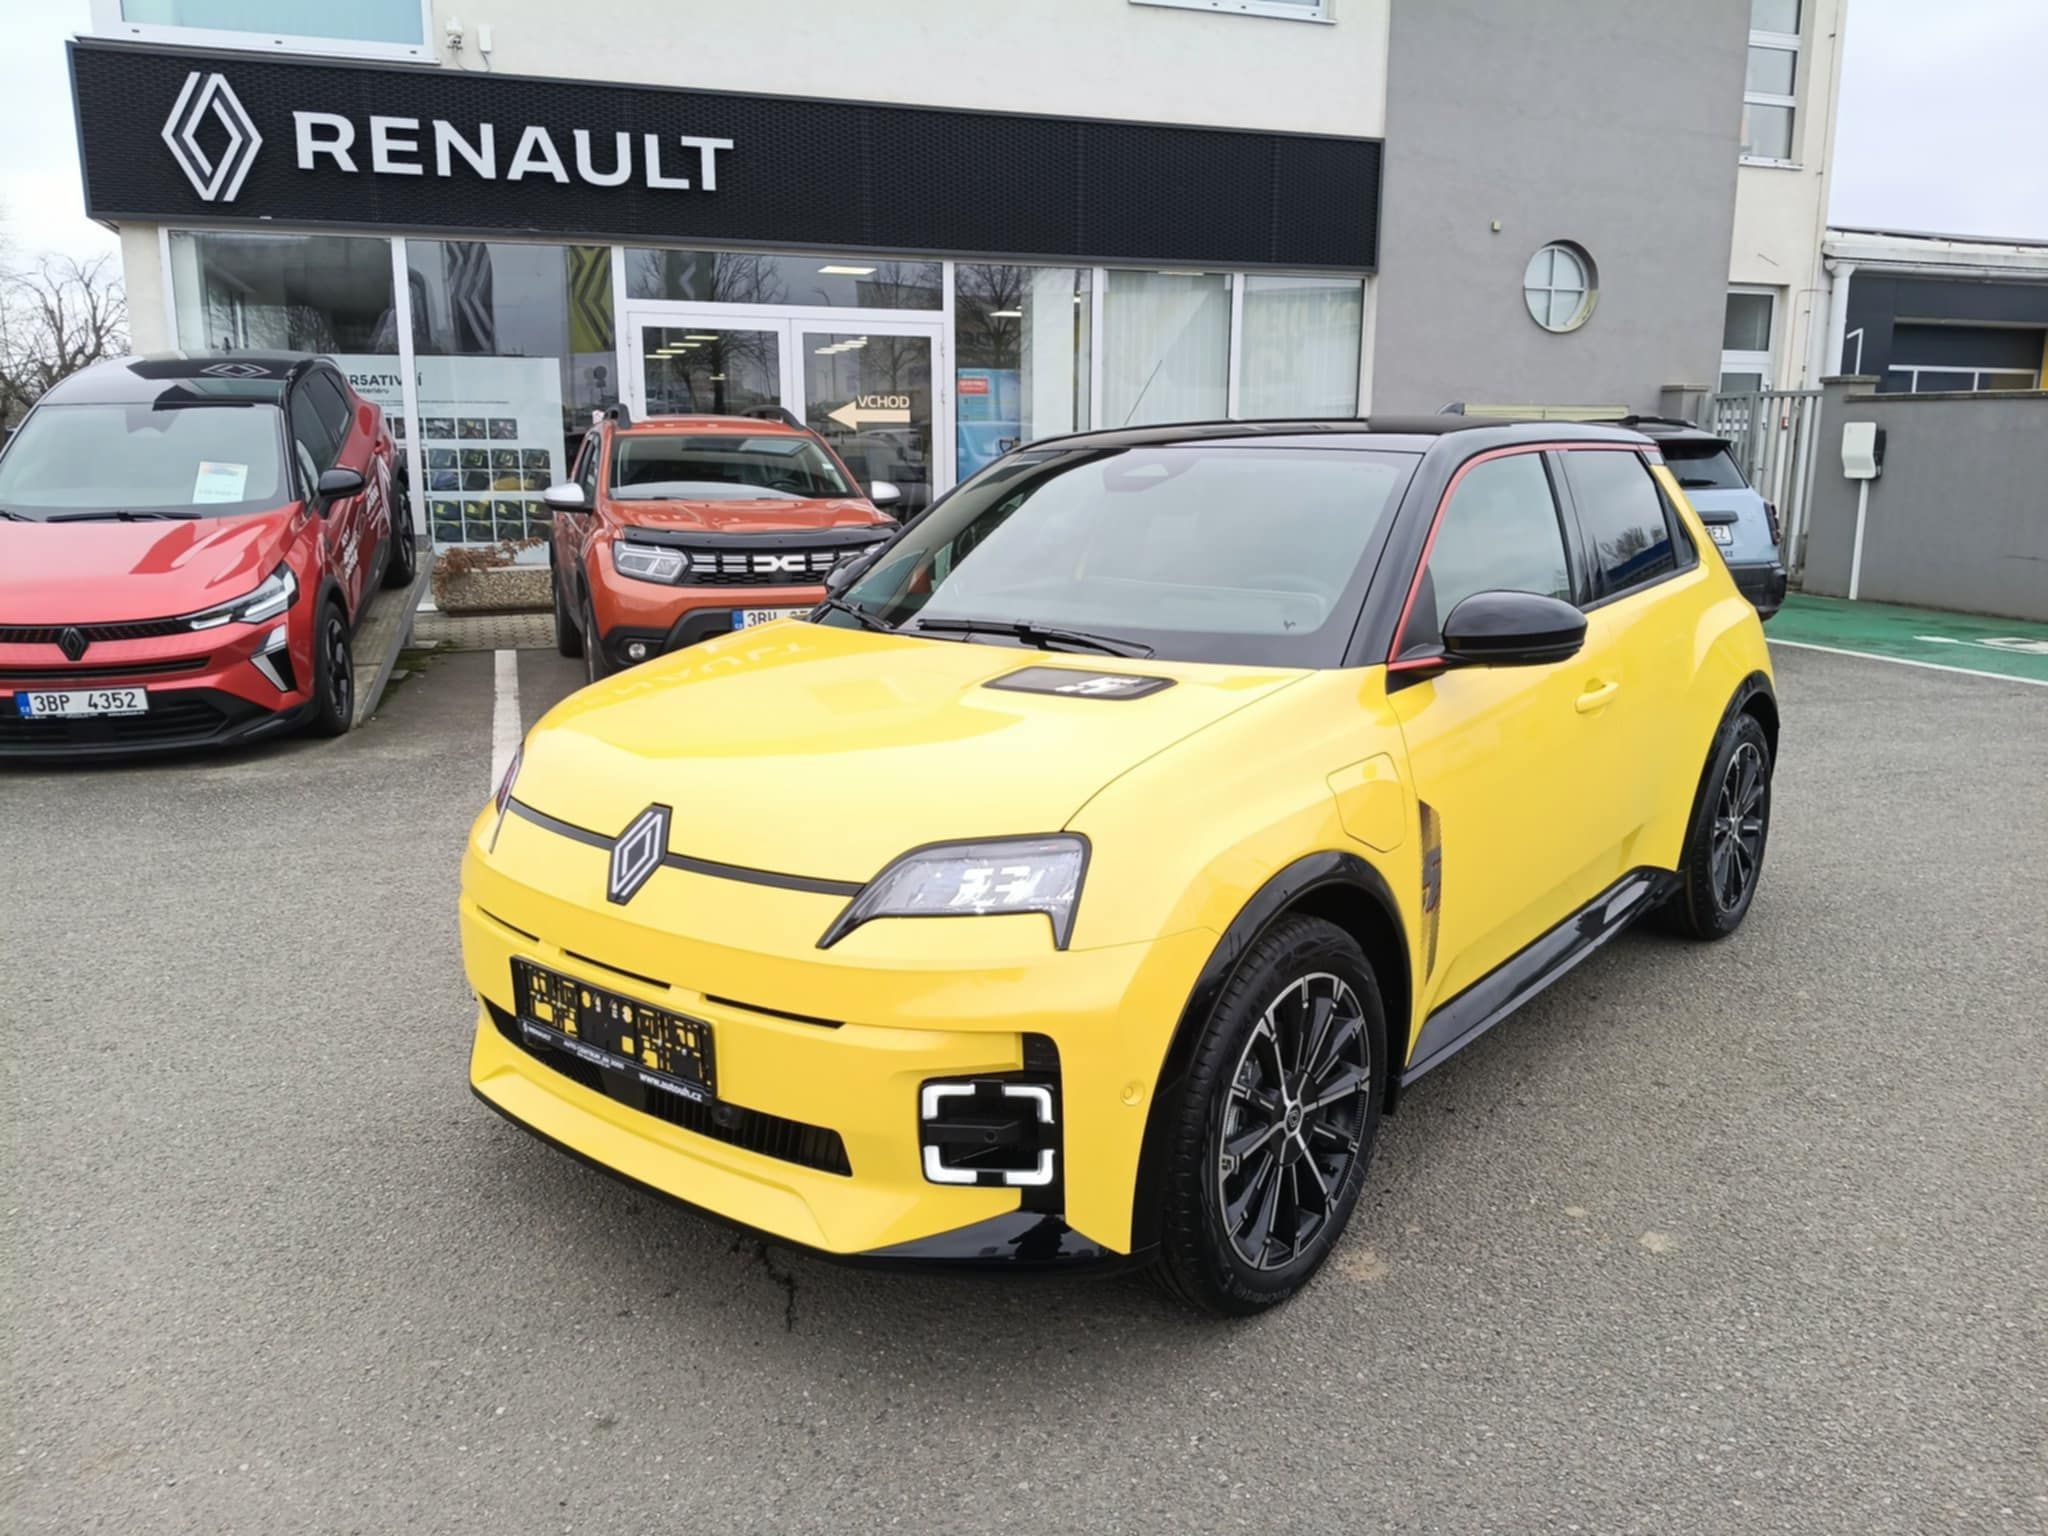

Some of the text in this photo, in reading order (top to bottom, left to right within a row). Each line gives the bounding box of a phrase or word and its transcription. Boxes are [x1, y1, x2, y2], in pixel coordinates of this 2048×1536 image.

[292, 111, 735, 192] RENAULT
[857, 395, 910, 408] VCHOD
[33, 691, 138, 712] 3BP 4352
